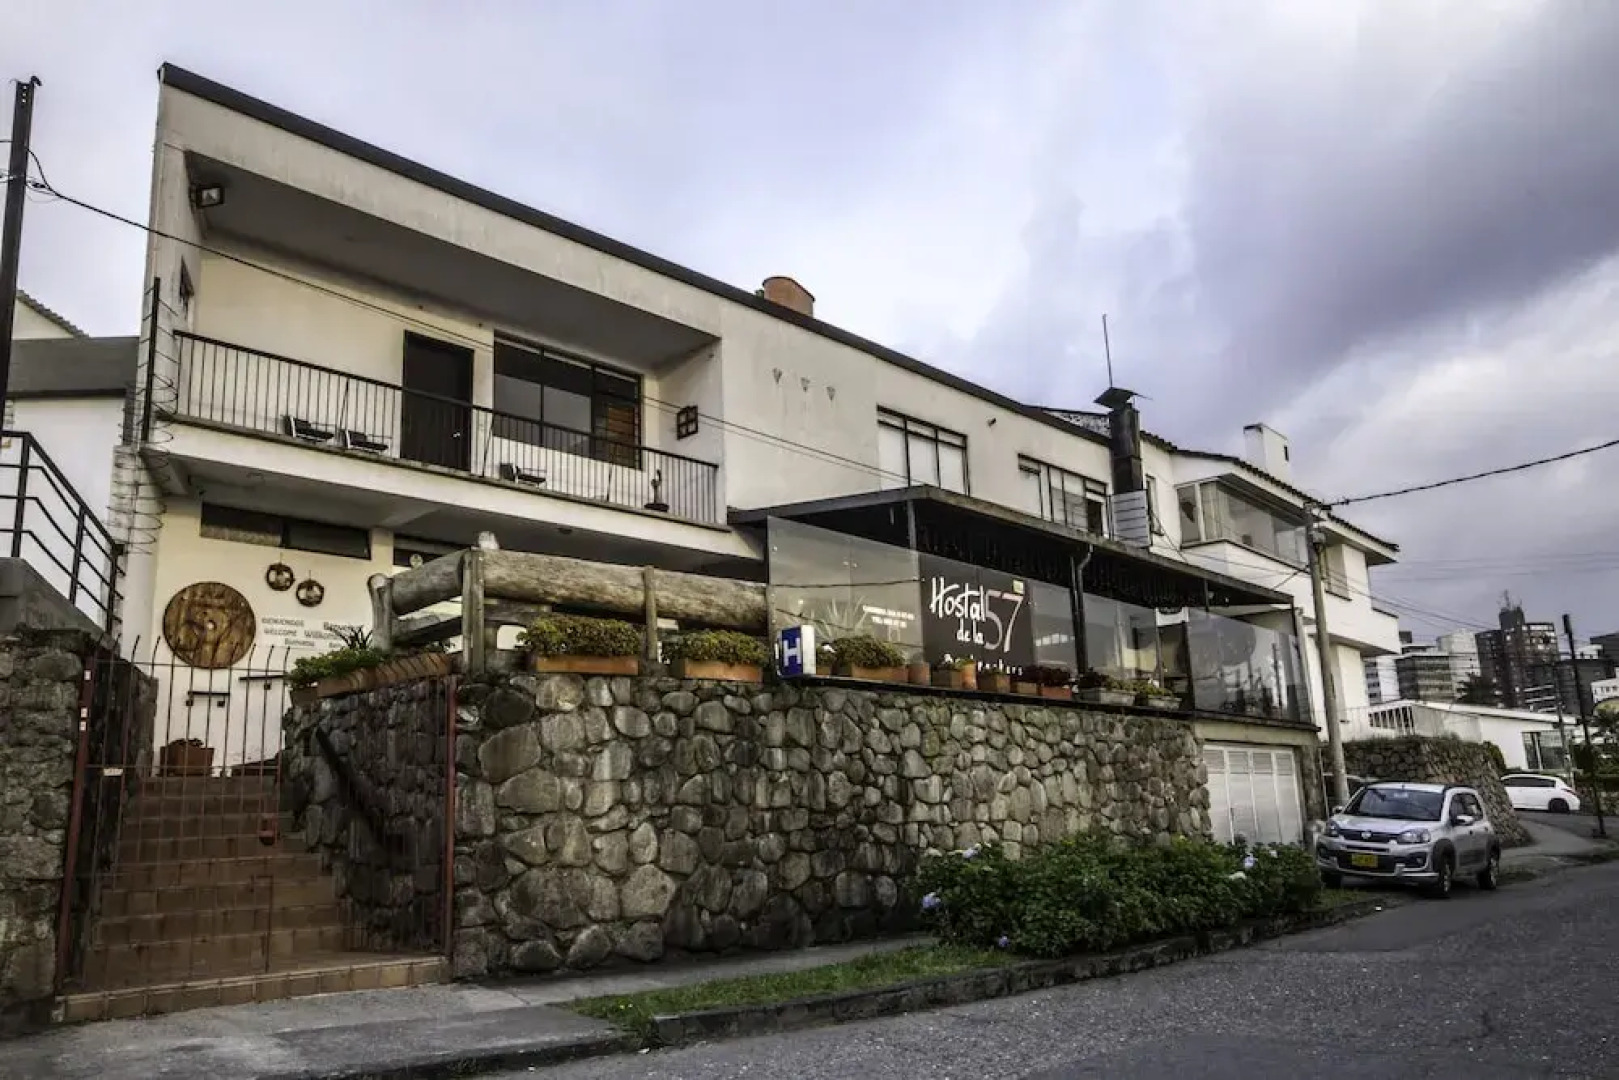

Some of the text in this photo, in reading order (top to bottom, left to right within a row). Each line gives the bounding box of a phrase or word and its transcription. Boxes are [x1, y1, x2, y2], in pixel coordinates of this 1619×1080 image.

[929, 576, 1023, 653] Hostal 57
[956, 618, 985, 644] de la
[783, 637, 801, 667] H
